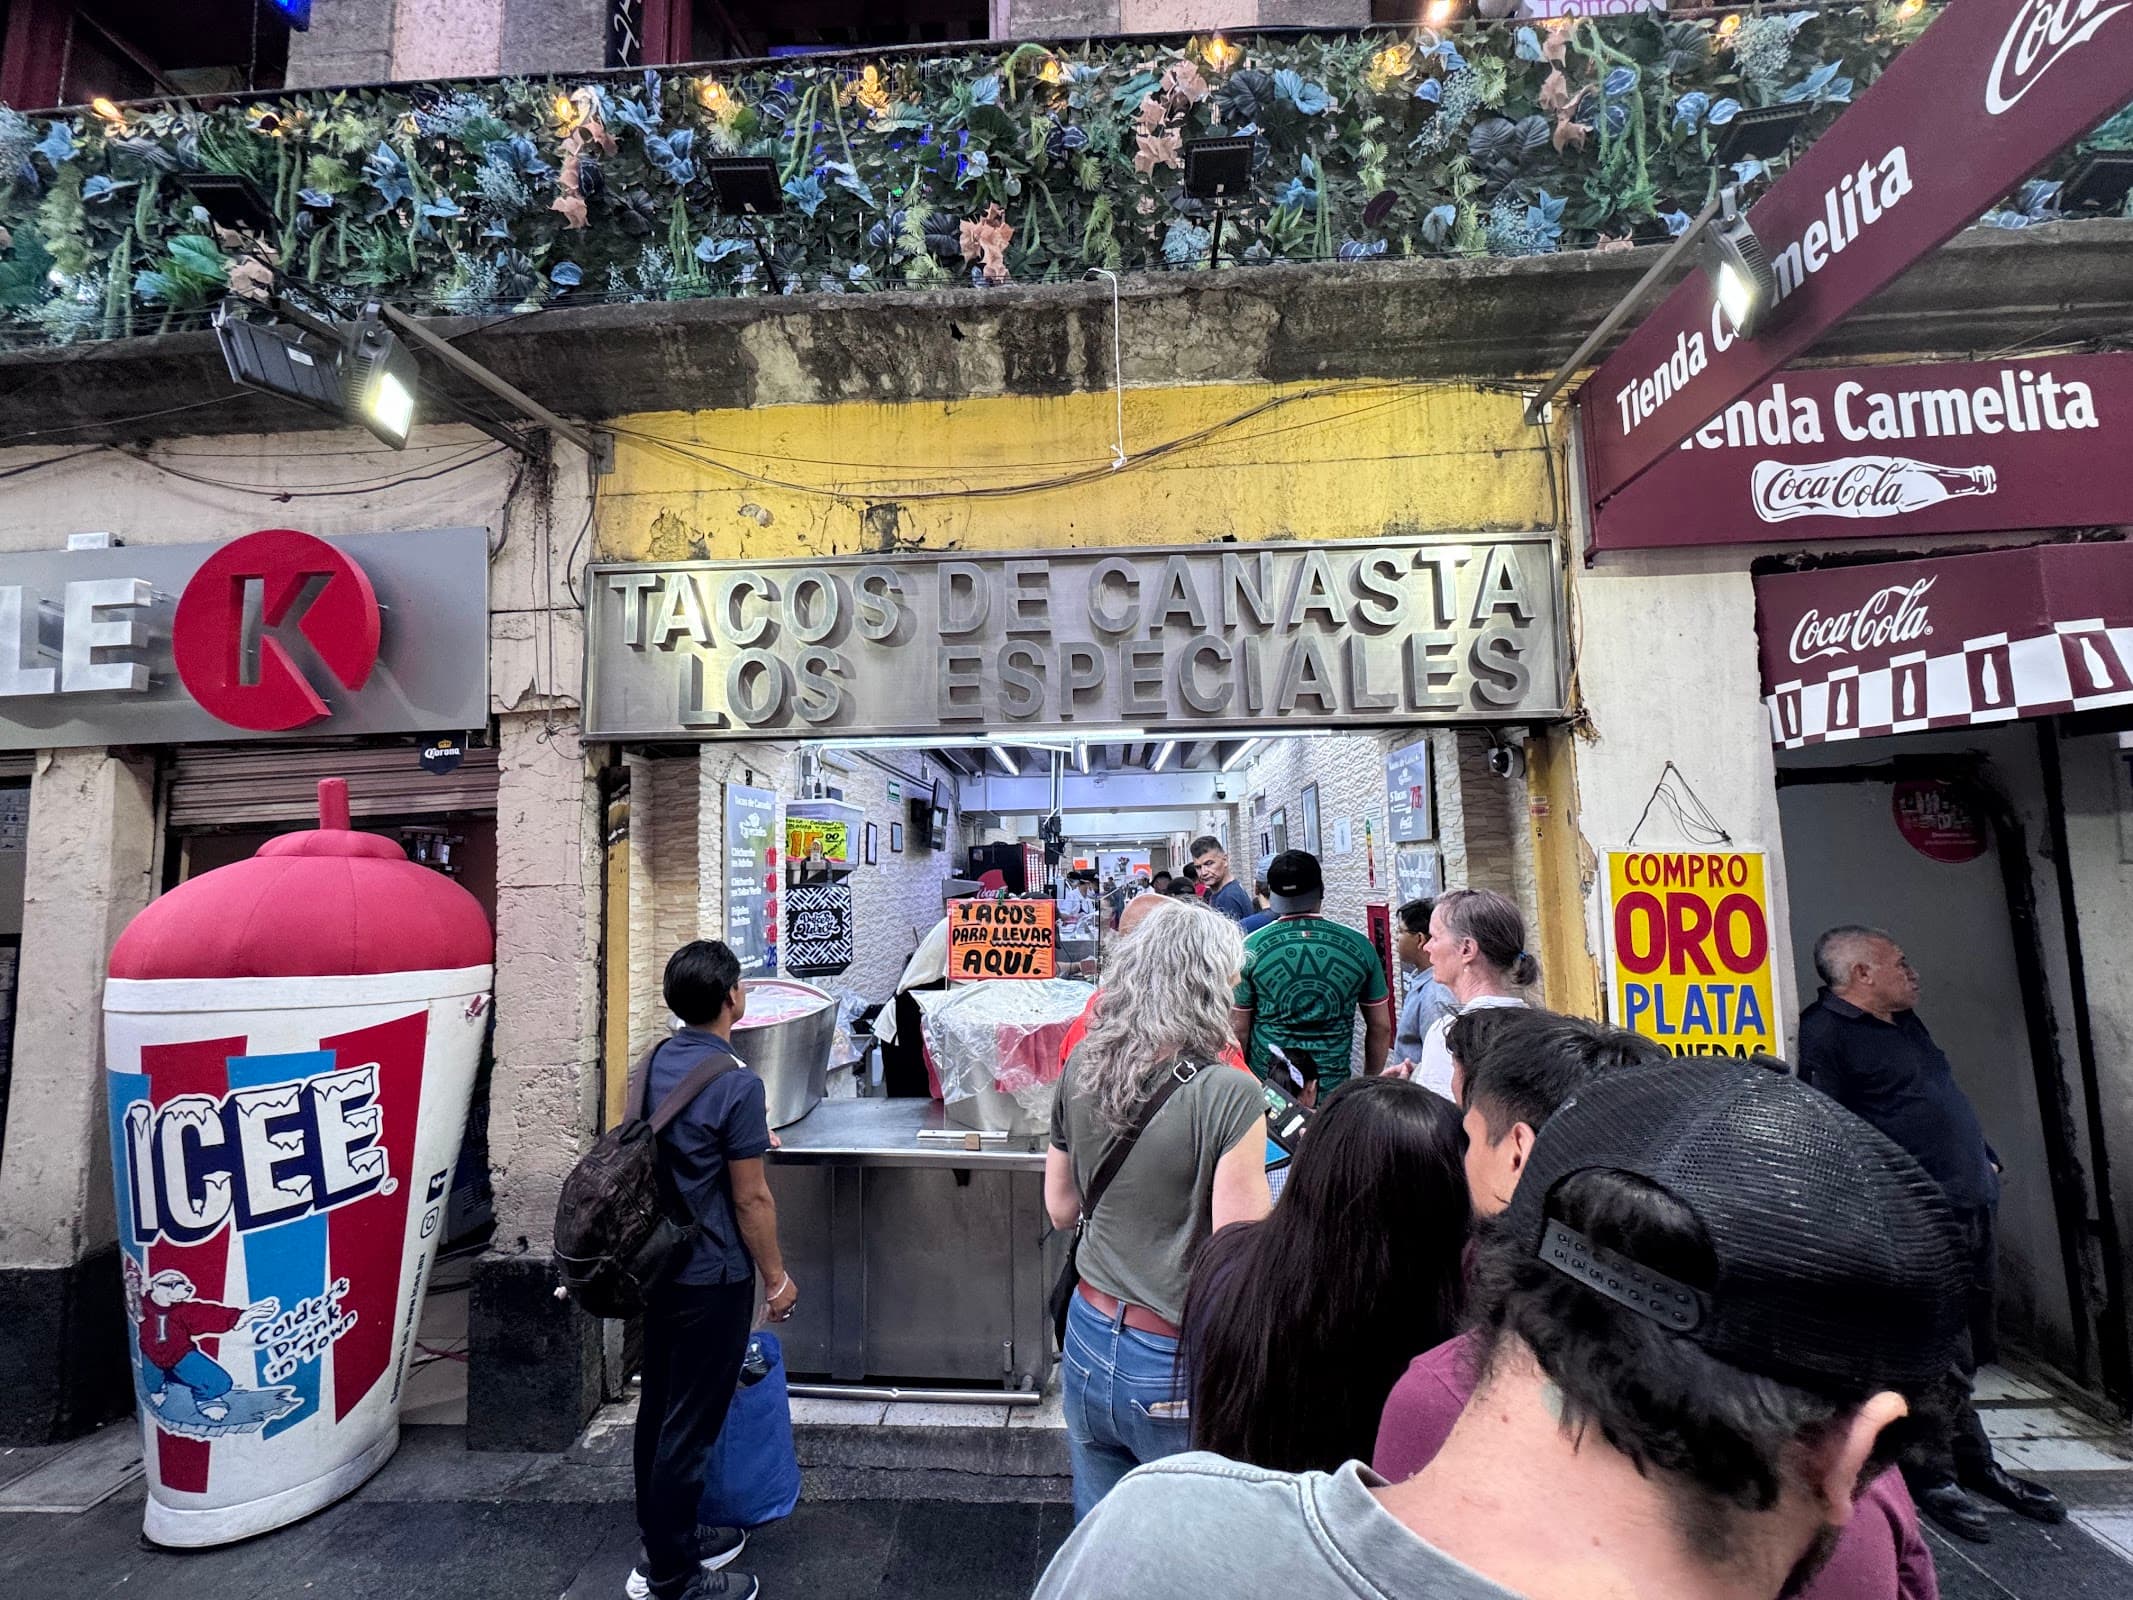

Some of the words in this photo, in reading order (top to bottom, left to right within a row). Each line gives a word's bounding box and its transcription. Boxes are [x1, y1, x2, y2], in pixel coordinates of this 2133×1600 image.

[1616, 331, 1708, 436] Tienda
[1711, 145, 1913, 353] Cmelita
[1680, 383, 1825, 450] enda
[1834, 368, 2099, 442] Carmelita
[609, 564, 904, 651] TACOS
[937, 560, 1052, 637] DE
[1087, 544, 1536, 634] CANASTA
[679, 645, 846, 729] LOS
[936, 627, 1533, 724] ESPECIALES
[424, 748, 460, 759] Corona
[1624, 854, 1748, 887] COMPRO
[952, 927, 988, 945] PARA
[991, 927, 1052, 943] LLEVAR
[958, 904, 1037, 925] TACOS
[1614, 891, 1768, 975] ORO
[1625, 983, 1766, 1035] PLATA
[124, 1065, 386, 1244] ICEE
[254, 1278, 350, 1345] Coldest
[270, 1358, 295, 1378] in
[300, 1311, 358, 1356] Town
[274, 1304, 340, 1360] Drink
